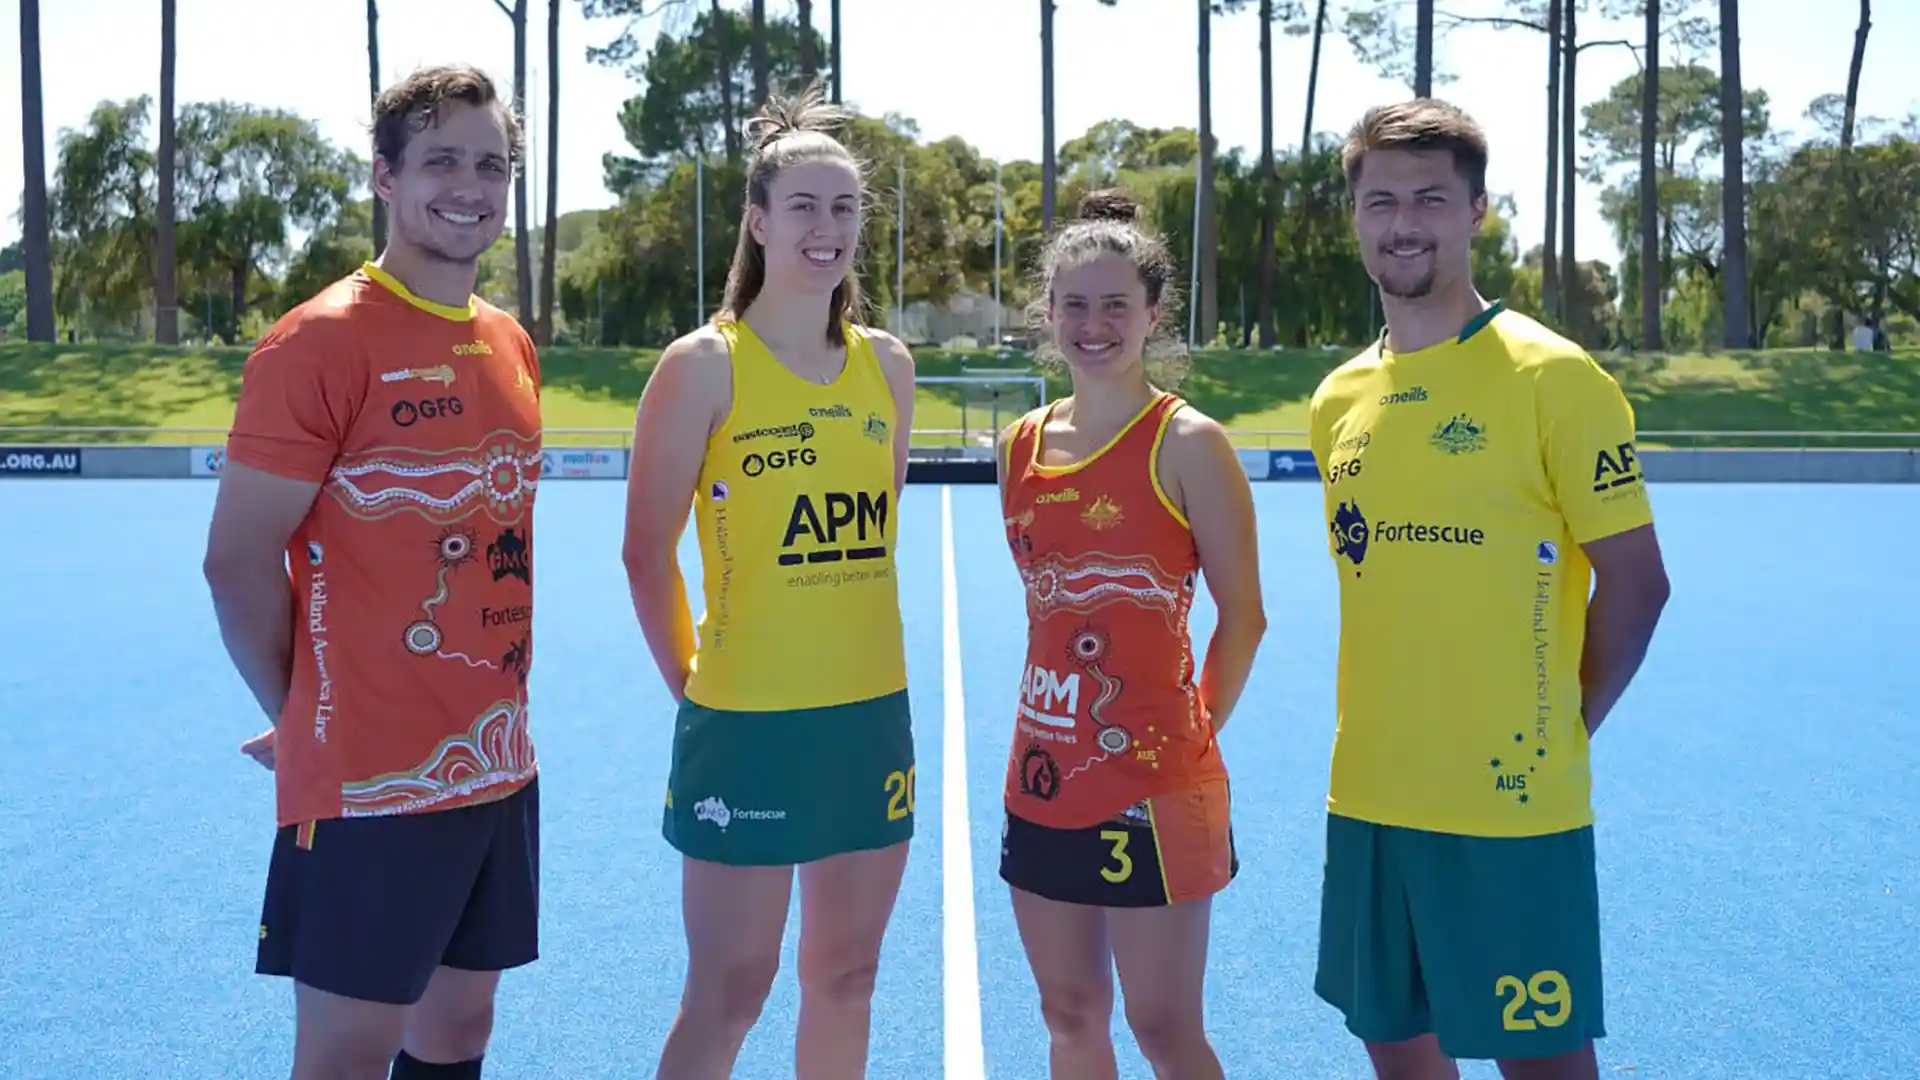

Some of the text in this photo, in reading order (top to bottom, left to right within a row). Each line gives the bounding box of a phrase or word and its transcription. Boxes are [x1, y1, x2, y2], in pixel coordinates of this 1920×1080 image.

[420, 396, 463, 419] GFG
[1379, 385, 1428, 405] oneills
[767, 448, 817, 469] GFG
[1594, 442, 1636, 482] AP
[782, 489, 887, 547] APM
[1374, 520, 1484, 546] Fortescue
[310, 573, 328, 633] Holland
[1533, 572, 1552, 632] Holland
[1021, 664, 1080, 714] APM
[315, 704, 333, 743] Line
[1536, 704, 1551, 742] Line
[1136, 750, 1157, 761] AUS
[1495, 774, 1527, 791] AUS
[732, 808, 787, 820] Fortescue
[1100, 830, 1133, 884] 3
[1495, 970, 1571, 1031] 29
